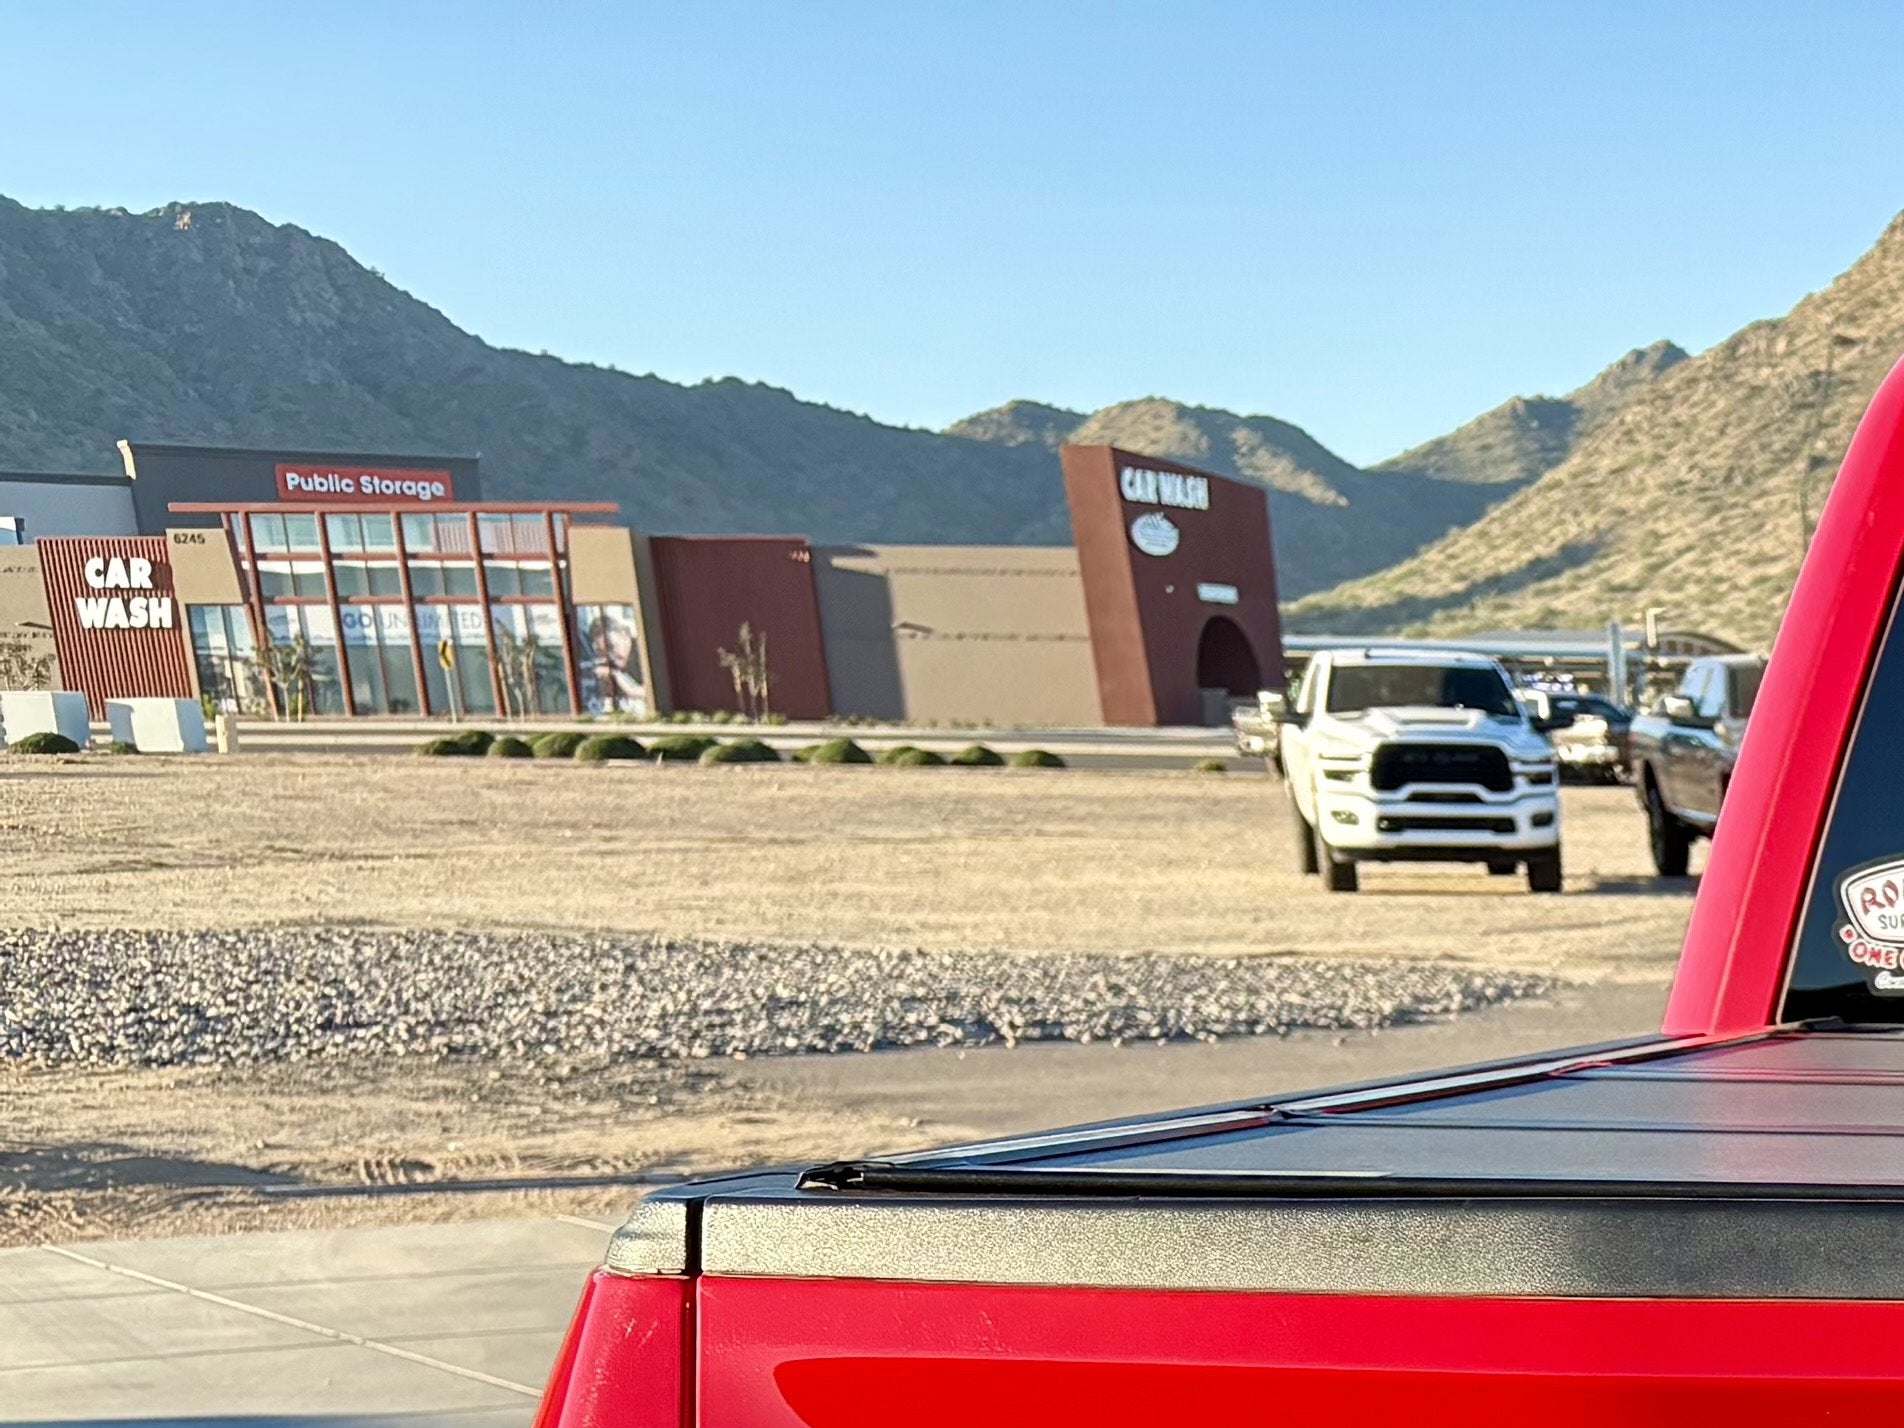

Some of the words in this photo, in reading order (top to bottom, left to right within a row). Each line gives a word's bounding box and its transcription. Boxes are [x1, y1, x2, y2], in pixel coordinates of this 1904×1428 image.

[286, 472, 354, 493] Public
[360, 475, 445, 501] Storage
[1121, 466, 1158, 504] CAR
[1160, 471, 1210, 510] WASH
[84, 556, 153, 589] CAR
[75, 597, 173, 629] WASH
